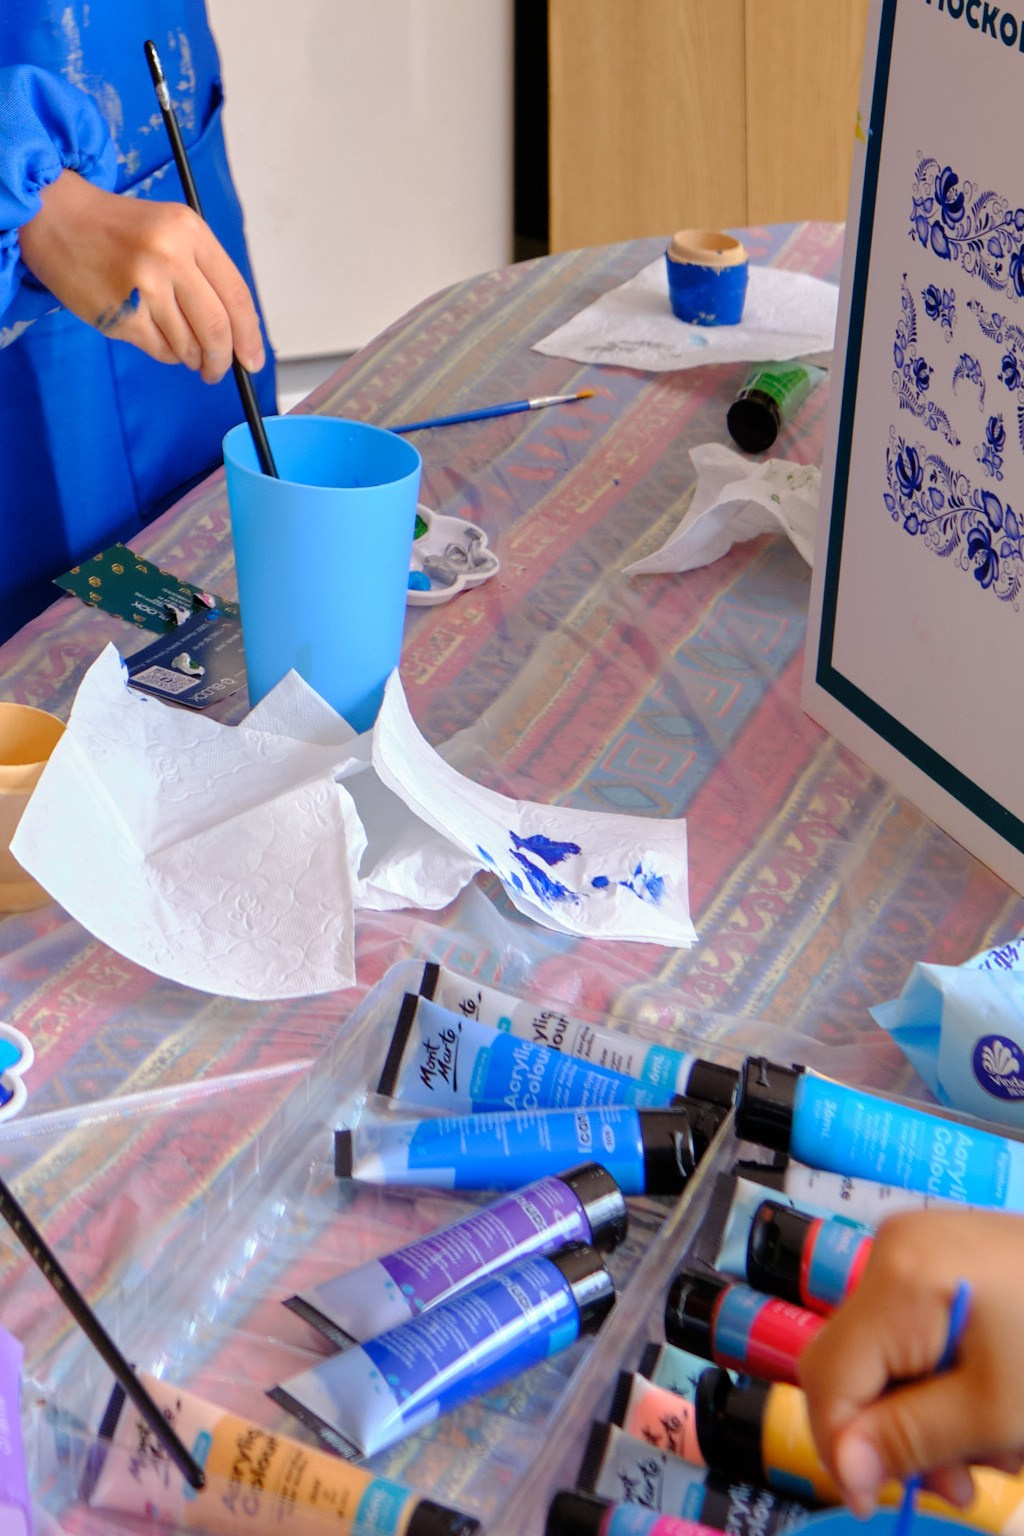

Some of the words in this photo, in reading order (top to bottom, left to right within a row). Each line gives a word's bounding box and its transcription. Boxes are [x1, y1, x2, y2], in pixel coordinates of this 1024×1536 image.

[420, 1038, 440, 1091] Mont
[438, 1028, 458, 1085] Marte
[927, 1127, 953, 1194] Colou
[948, 1130, 974, 1203] Acryli
